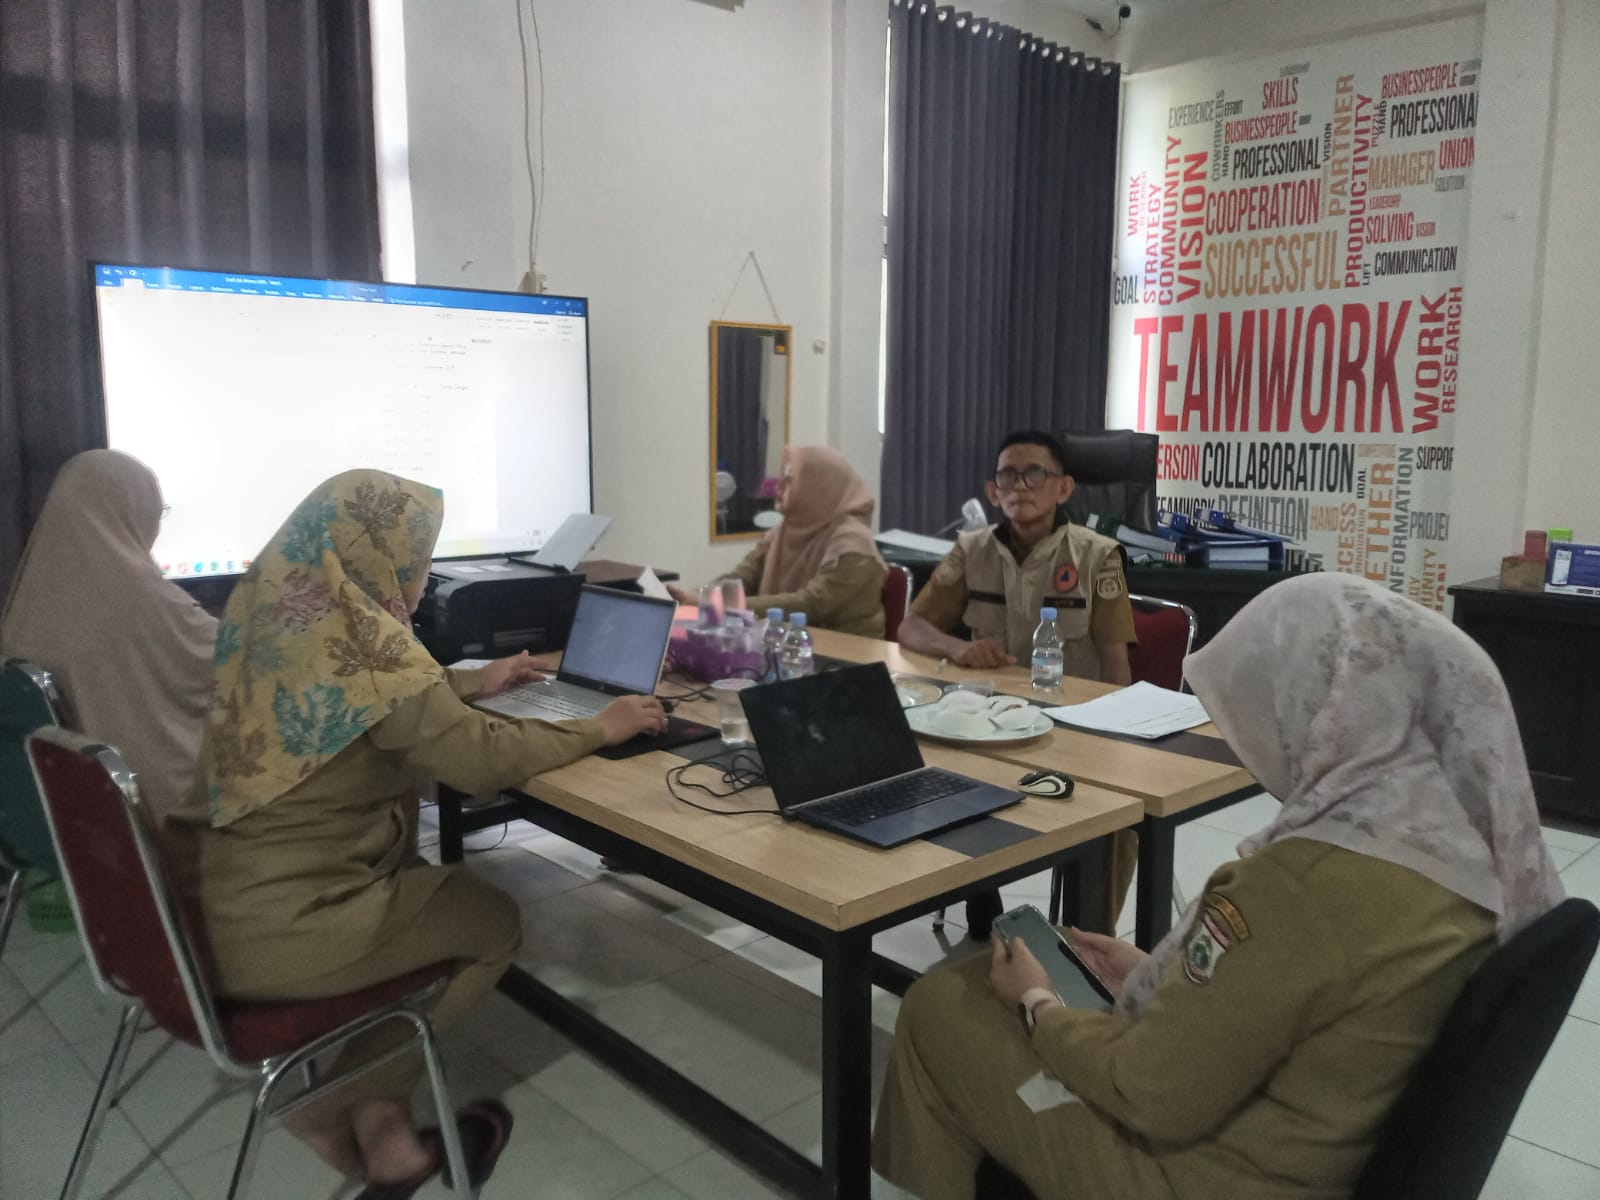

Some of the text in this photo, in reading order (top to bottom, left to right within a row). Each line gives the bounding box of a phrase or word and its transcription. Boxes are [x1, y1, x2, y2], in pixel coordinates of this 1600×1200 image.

[1263, 76, 1299, 110] SKILLS
[1381, 62, 1459, 99] BUSINESSPEOPLE
[1169, 100, 1215, 129] EXPERIENCE
[1212, 89, 1225, 182] COWORKERS
[1225, 110, 1298, 144] BUSINESSPEOPLE
[1221, 145, 1230, 177] HAND
[1233, 136, 1321, 181] PROFESSIONAL
[1322, 122, 1332, 162] VISION
[1328, 73, 1354, 216] PARTNER
[1439, 136, 1475, 170] UNION
[1345, 94, 1372, 288] PRODUCTIVITY
[1368, 150, 1436, 190] MANAGER
[1128, 175, 1140, 236] WORK
[1158, 135, 1182, 305] COMMUNITY
[1177, 152, 1208, 303] VISION
[1206, 178, 1321, 236] COOPERATION
[1366, 212, 1415, 244] SOLVING
[1144, 183, 1161, 304] STRATEGY
[1204, 230, 1341, 299] SUCCESSFUL
[1374, 246, 1458, 276] COMMUNICATION
[1114, 275, 1139, 305] GOAL
[1134, 300, 1412, 433] TEAMWORK
[1412, 293, 1447, 434] WORK
[1442, 287, 1463, 413] RESEARCH
[1201, 441, 1355, 493] COLLABORATION
[1311, 504, 1339, 532] HAND
